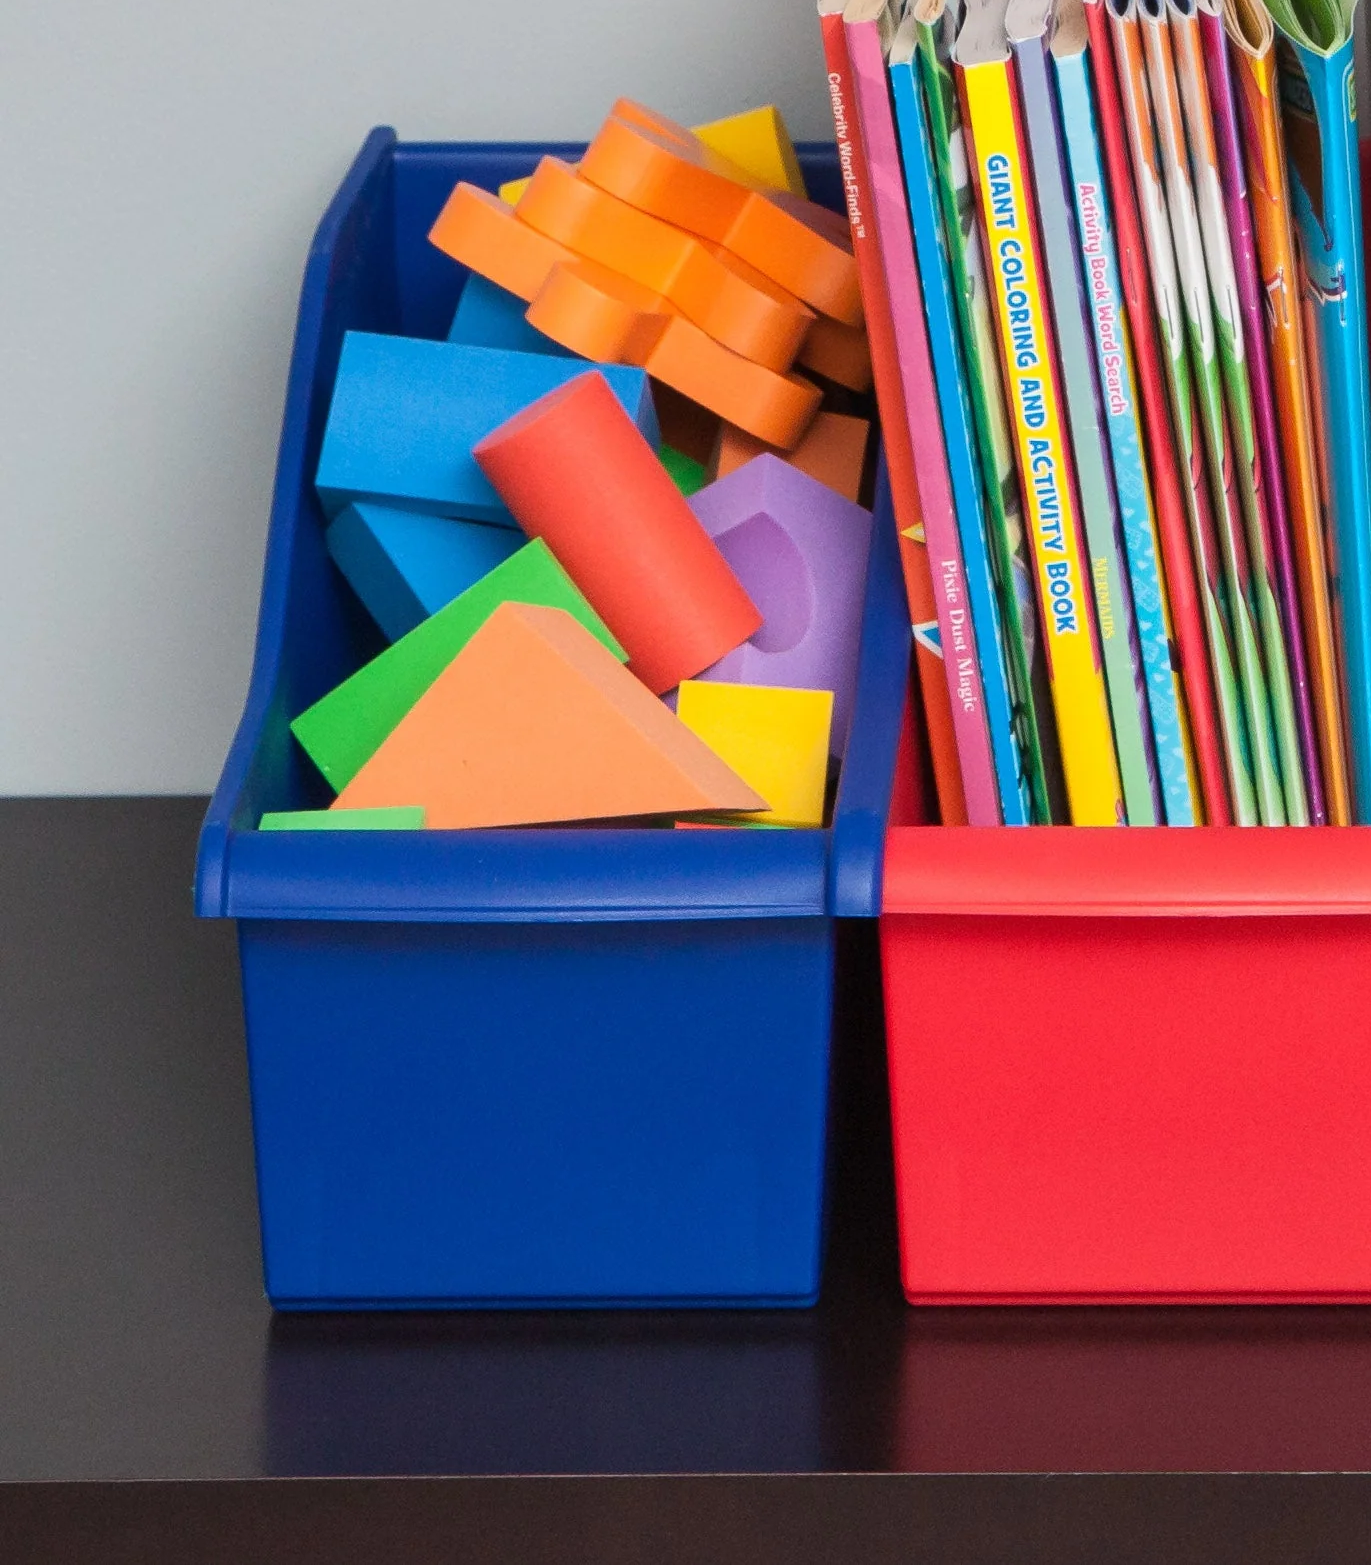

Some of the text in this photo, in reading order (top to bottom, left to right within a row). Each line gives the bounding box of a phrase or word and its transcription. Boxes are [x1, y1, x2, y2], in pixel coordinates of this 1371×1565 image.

[987, 154, 1076, 633] GIANT COLORING AND ACTIVITY BOOK
[1080, 185, 1128, 415] Activity Book Word Search
[941, 560, 978, 713] Pixie Dust Magic
